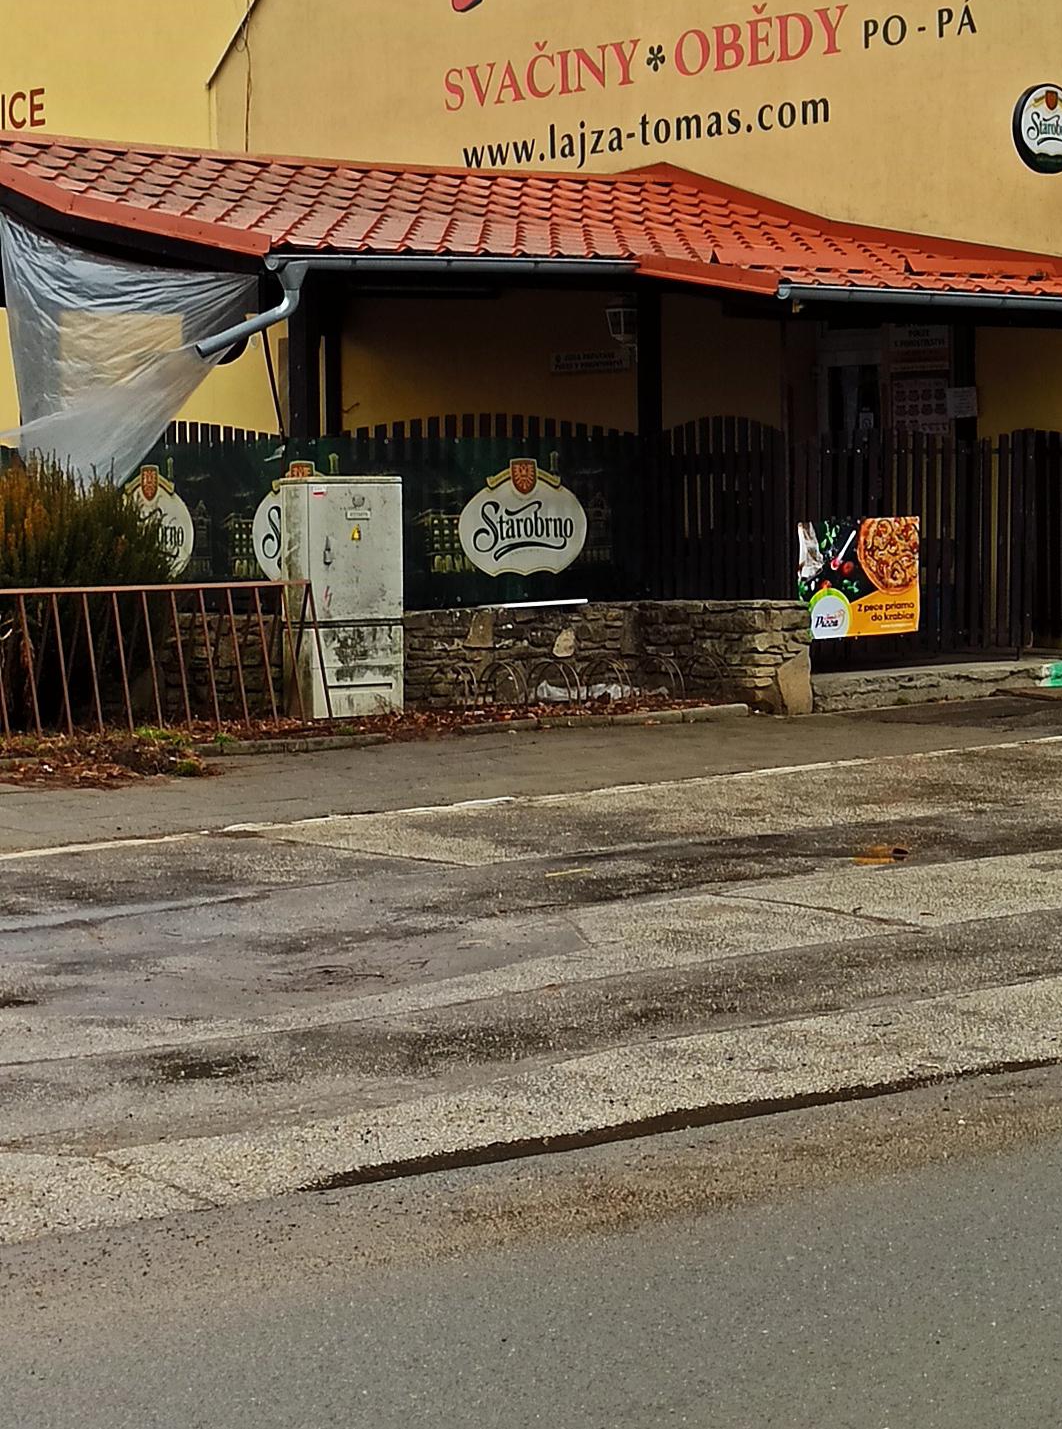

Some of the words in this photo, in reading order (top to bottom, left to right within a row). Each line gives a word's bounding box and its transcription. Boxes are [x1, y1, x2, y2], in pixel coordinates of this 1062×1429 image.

[444, 39, 641, 112] SVAČINY
[674, 2, 849, 76] OBĚDY
[863, 14, 907, 49] PO
[462, 97, 830, 169] www.lajza-tomas.com
[473, 500, 575, 562] Starobrno
[871, 613, 882, 621] do
